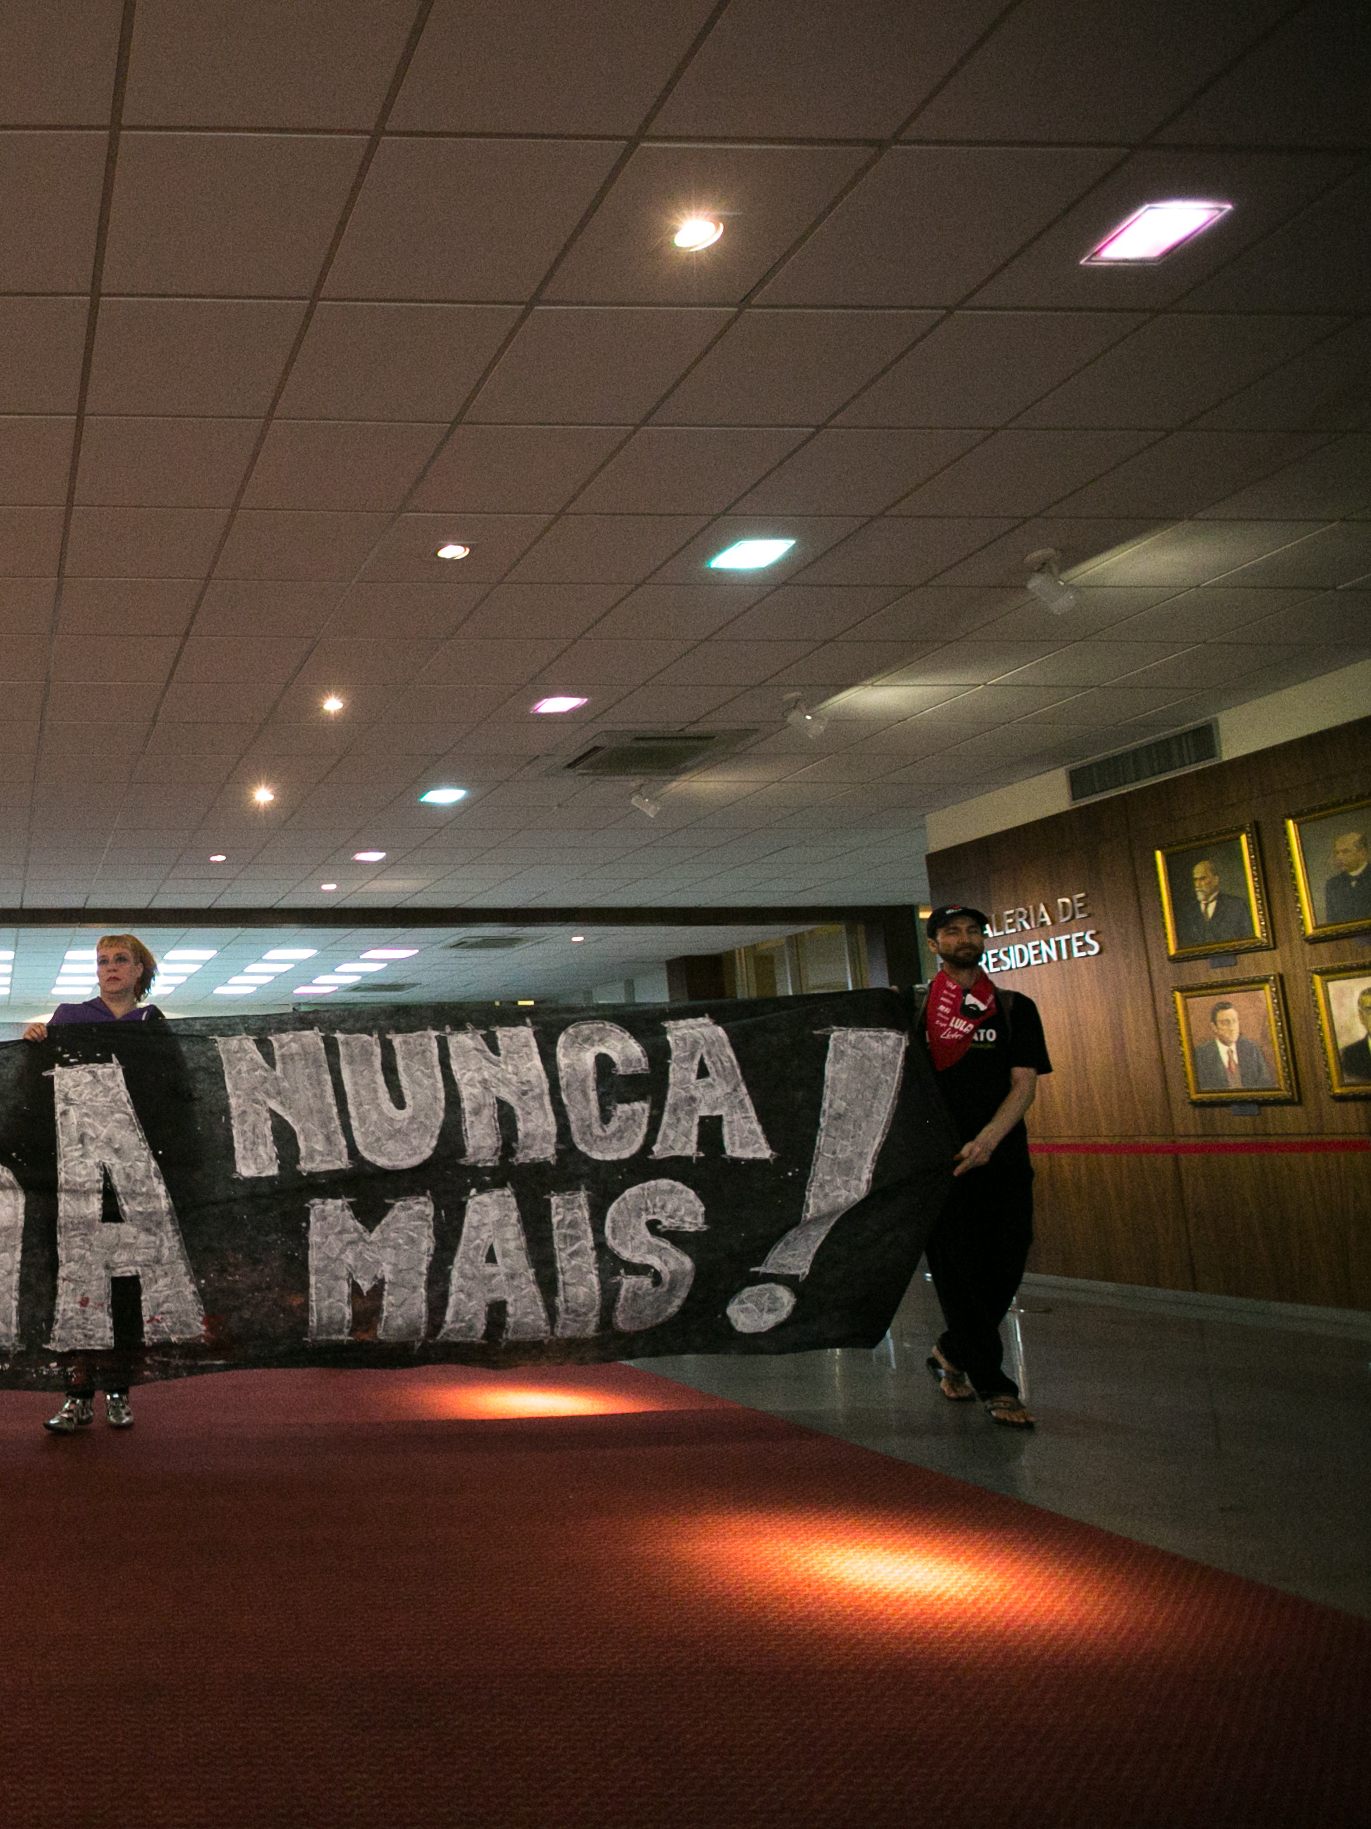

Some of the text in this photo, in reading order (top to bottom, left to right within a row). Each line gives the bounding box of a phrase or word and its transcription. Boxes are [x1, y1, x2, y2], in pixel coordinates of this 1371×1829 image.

[983, 892, 1089, 938] ALERIA DE
[978, 929, 1101, 975] RESIDENTES
[949, 1016, 974, 1034] LULA
[216, 1015, 773, 1177] NUNCA
[305, 1178, 709, 1343] MAIS
